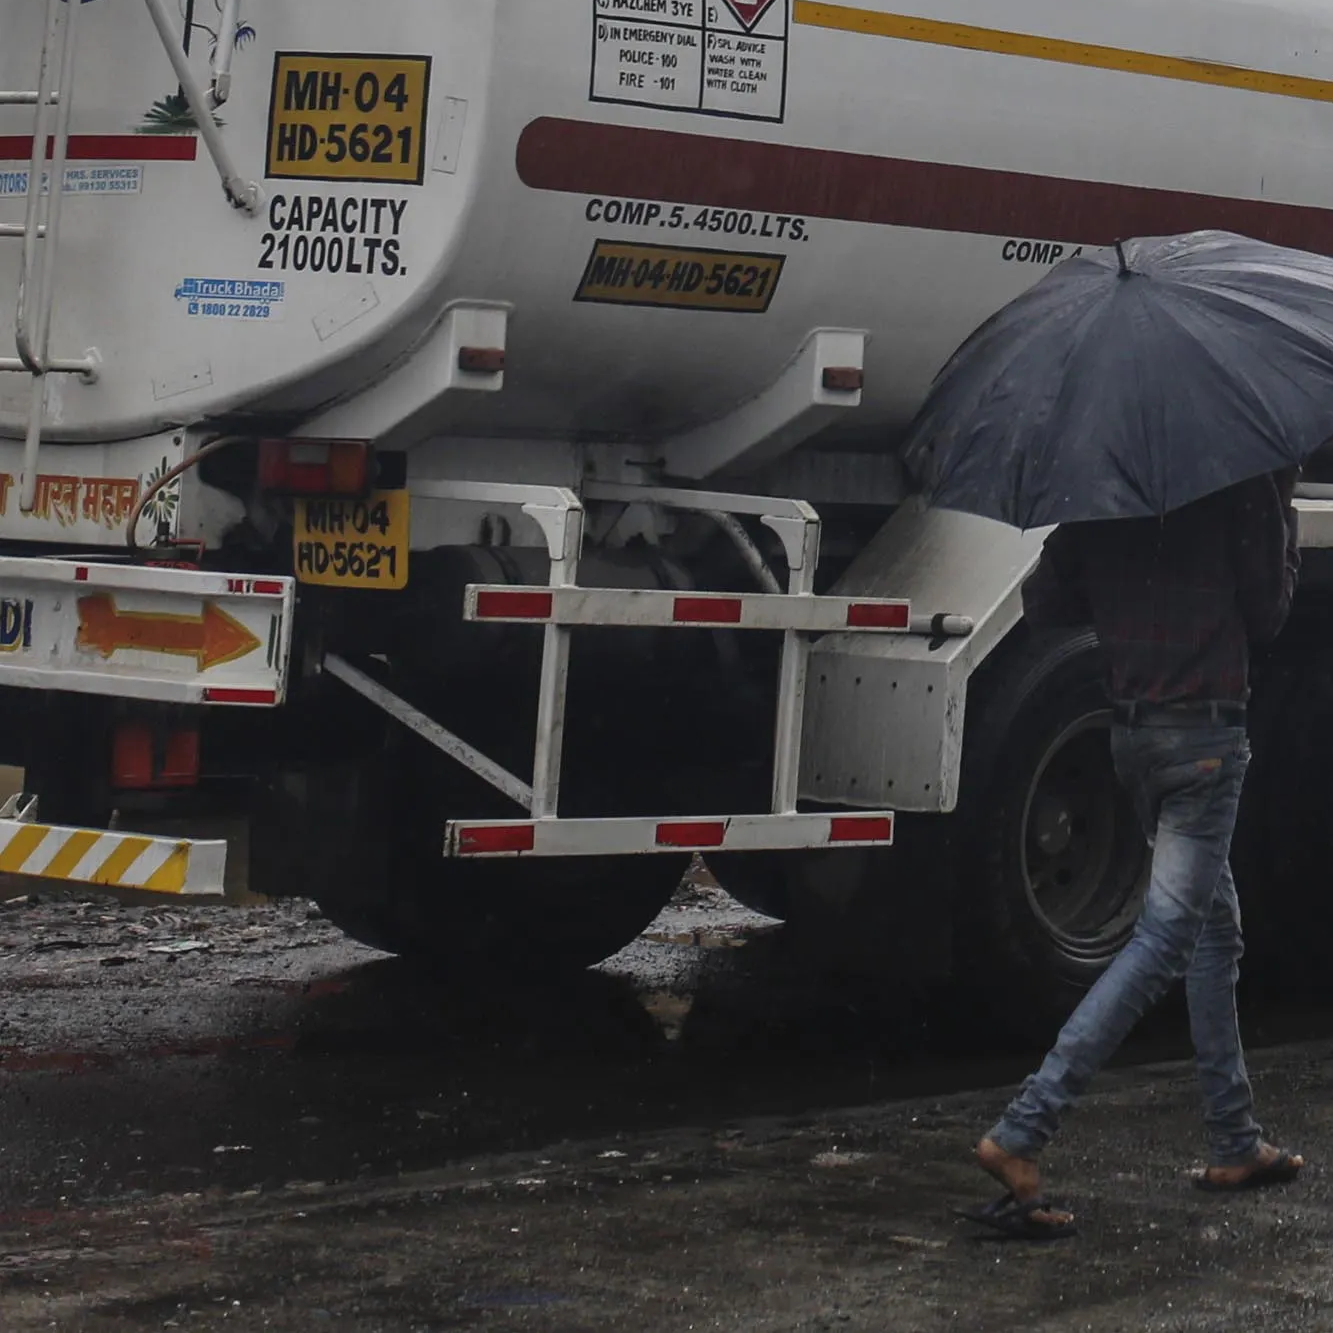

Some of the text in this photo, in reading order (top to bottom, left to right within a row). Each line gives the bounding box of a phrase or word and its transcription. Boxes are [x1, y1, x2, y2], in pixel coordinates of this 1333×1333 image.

[671, 0, 694, 18] 3YE
[708, 6, 718, 24] E)
[610, 27, 621, 41] IN
[677, 33, 697, 48] DIAL
[709, 54, 762, 69] WASH WITH
[619, 72, 644, 89] FIRE
[707, 67, 767, 82] WATER CLEAN
[706, 79, 758, 94] WITH CLOTH
[90, 168, 138, 179] SERVICES
[269, 194, 408, 235] CAPACITY
[201, 303, 226, 316] 1800
[227, 304, 241, 317] 22
